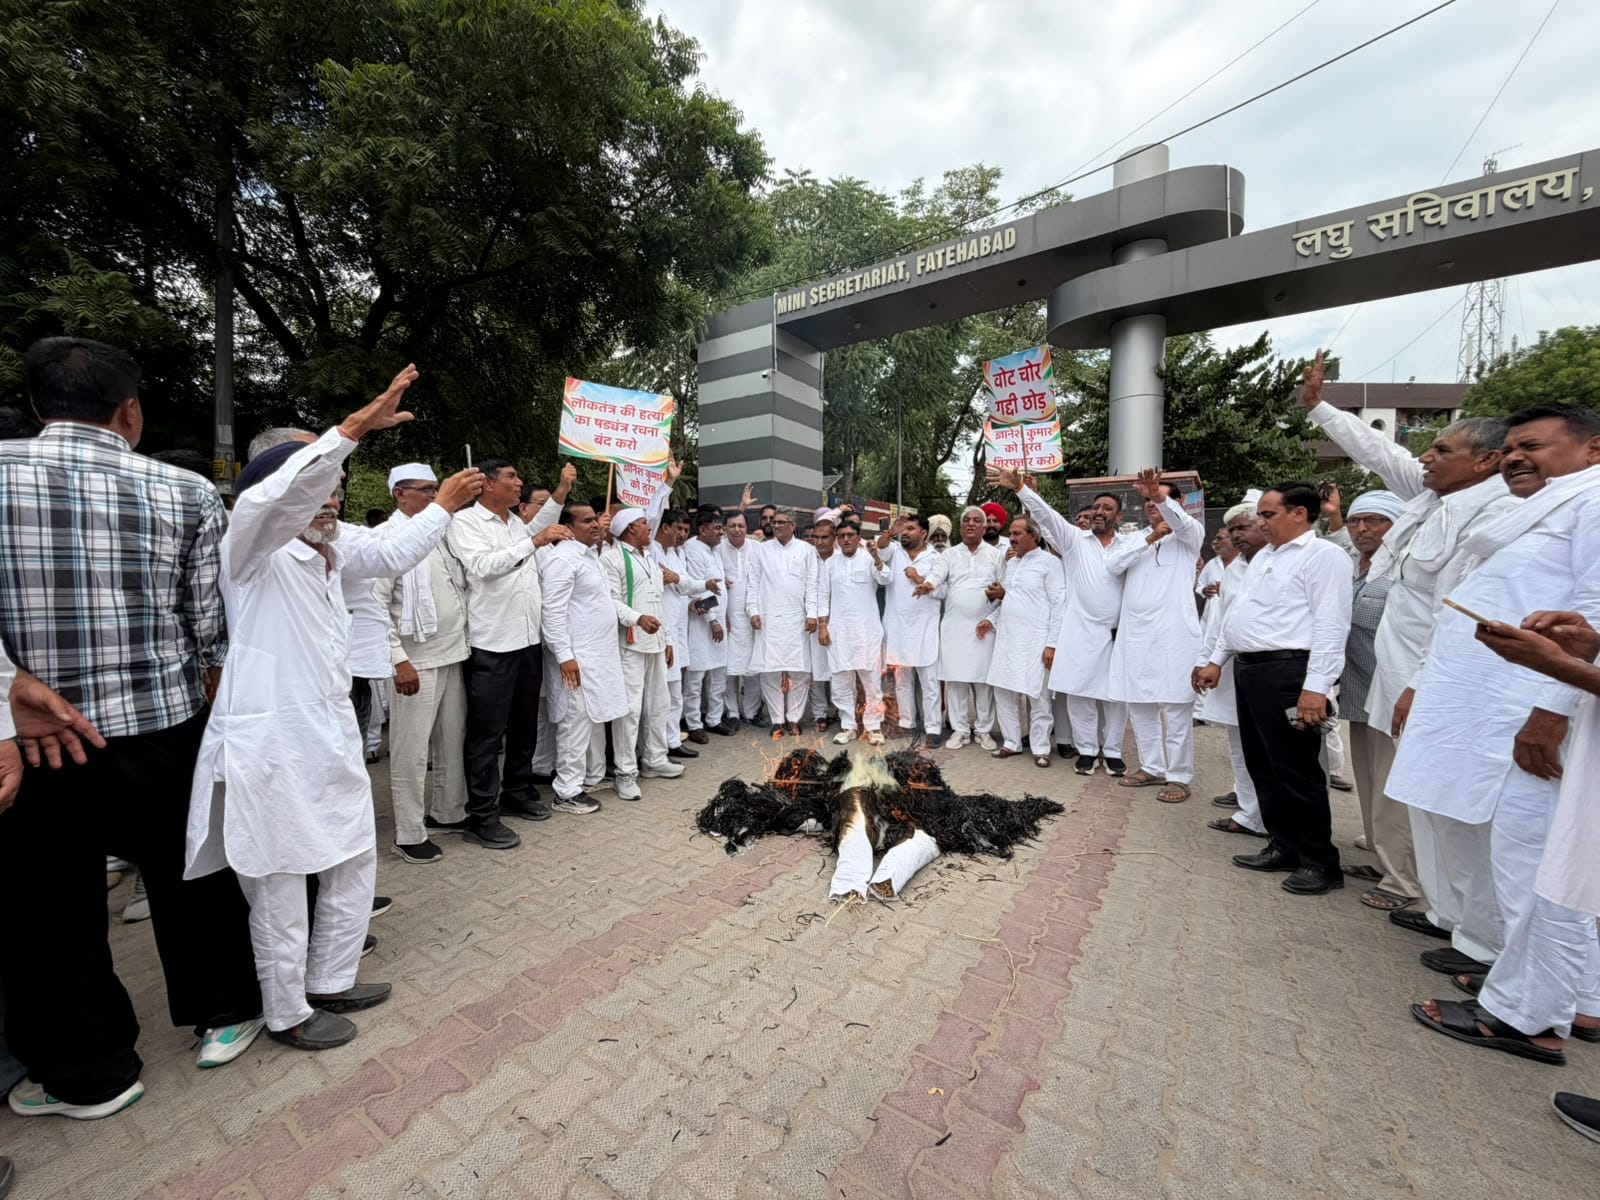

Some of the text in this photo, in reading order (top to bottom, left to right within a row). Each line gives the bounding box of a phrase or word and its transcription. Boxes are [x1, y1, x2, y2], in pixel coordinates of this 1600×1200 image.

[1292, 219, 1355, 259] लघु
[777, 227, 1017, 315] MINI SECRETARIAT, FATEHABAD
[992, 360, 1042, 388] वोट चोर
[570, 396, 665, 422] लोकतंत्र की हत्या
[995, 389, 1047, 416] गद्दी छोड़
[575, 415, 592, 426] का
[632, 426, 659, 437] रचना
[1026, 427, 1052, 441] कुमार
[594, 432, 638, 451] बंद करो
[1004, 441, 1018, 453] को
[993, 453, 1056, 468] गिरफ्तर करो
[630, 478, 640, 489] को
